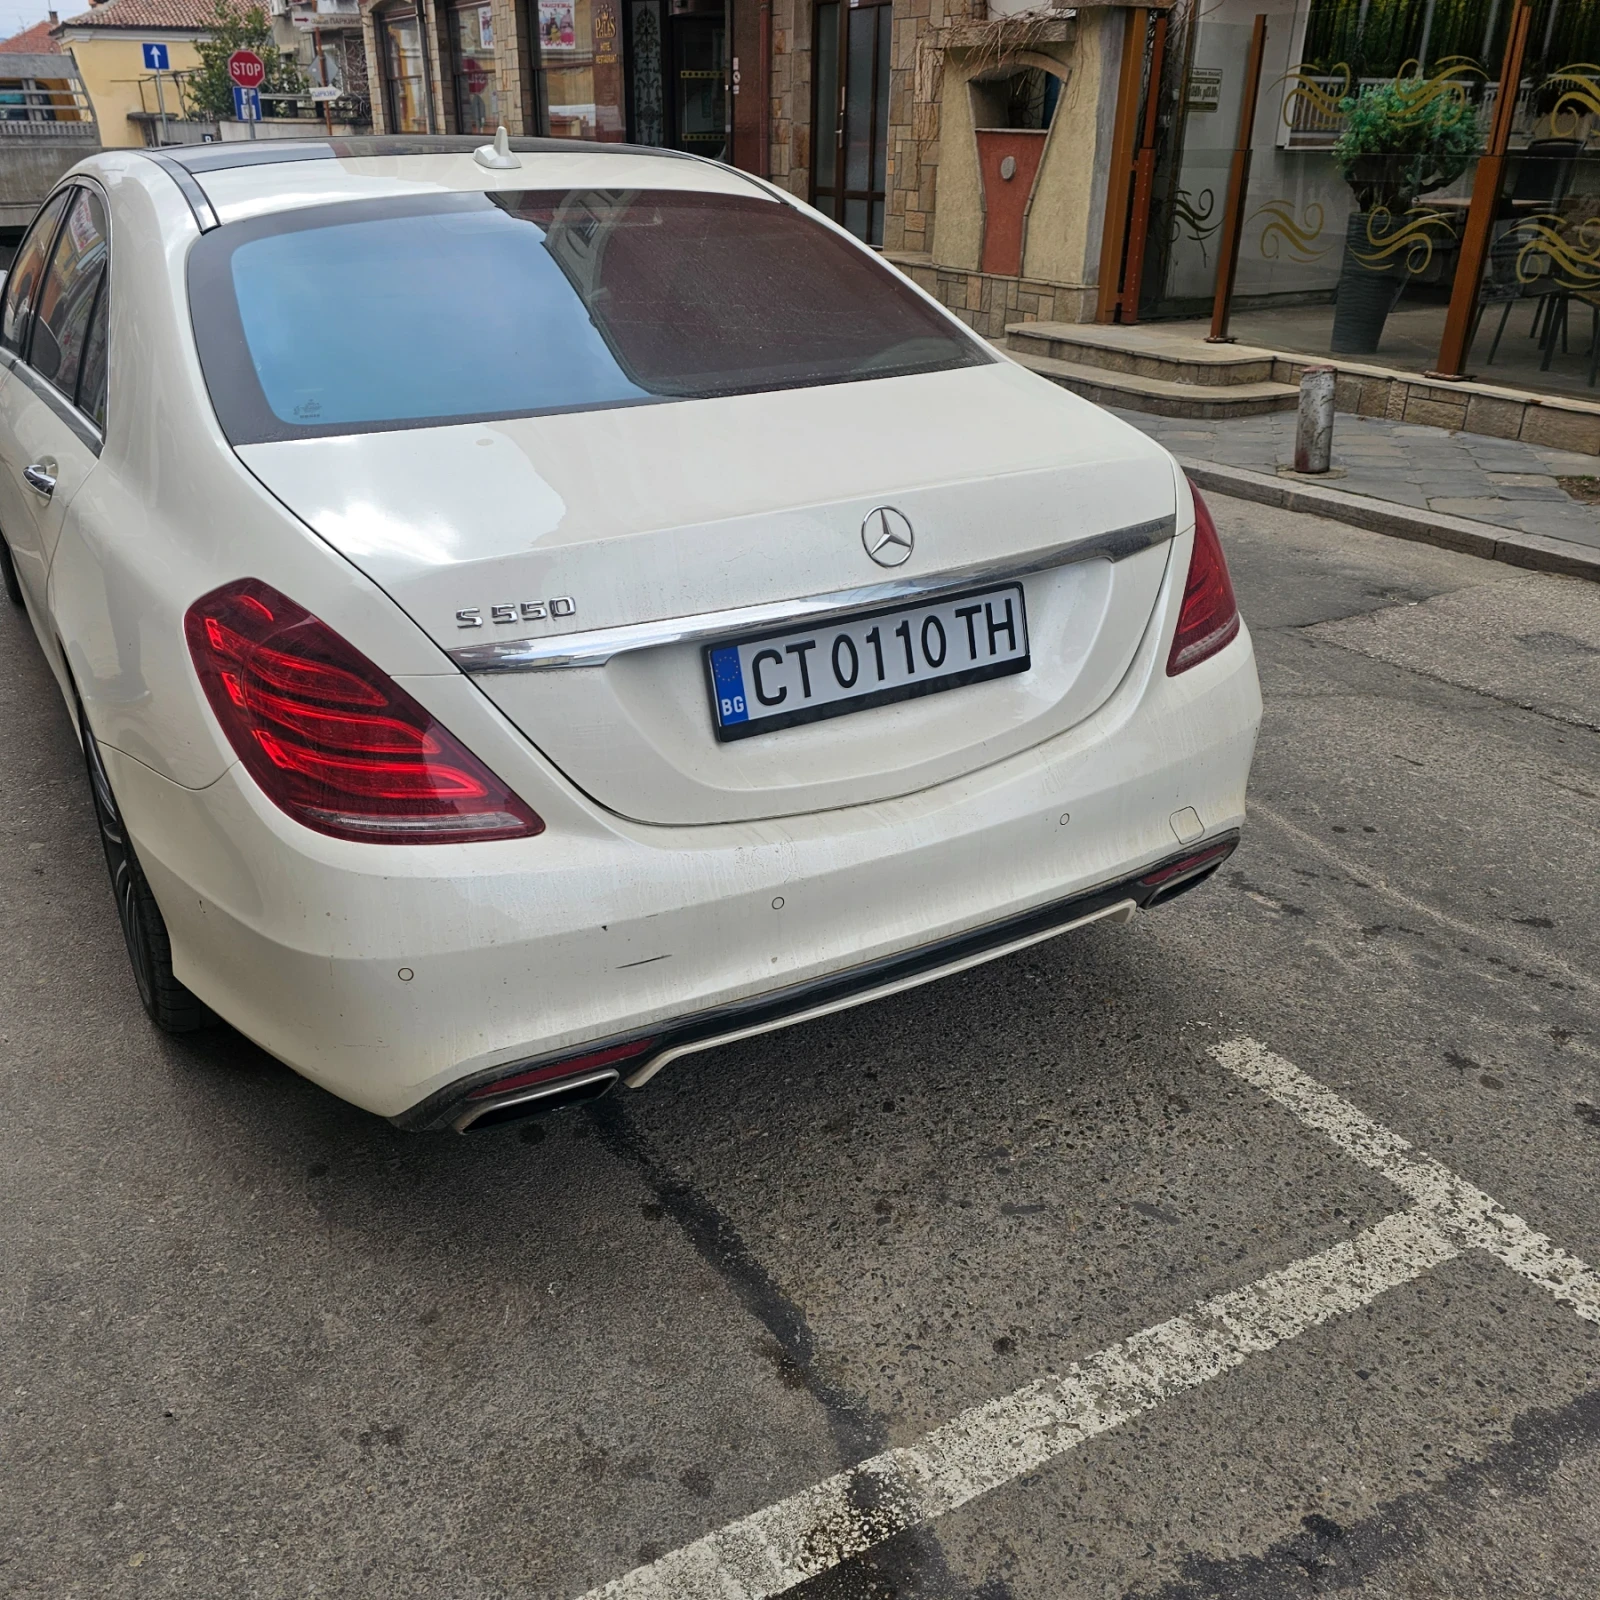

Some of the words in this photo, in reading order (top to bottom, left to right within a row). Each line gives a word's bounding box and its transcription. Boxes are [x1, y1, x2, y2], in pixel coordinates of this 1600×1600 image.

[232, 62, 260, 76] STOP
[456, 607, 483, 629] S
[491, 596, 576, 625] 550
[752, 640, 816, 706] CT
[831, 615, 947, 689] 0110
[955, 598, 1017, 660] TH
[722, 695, 744, 717] BG
